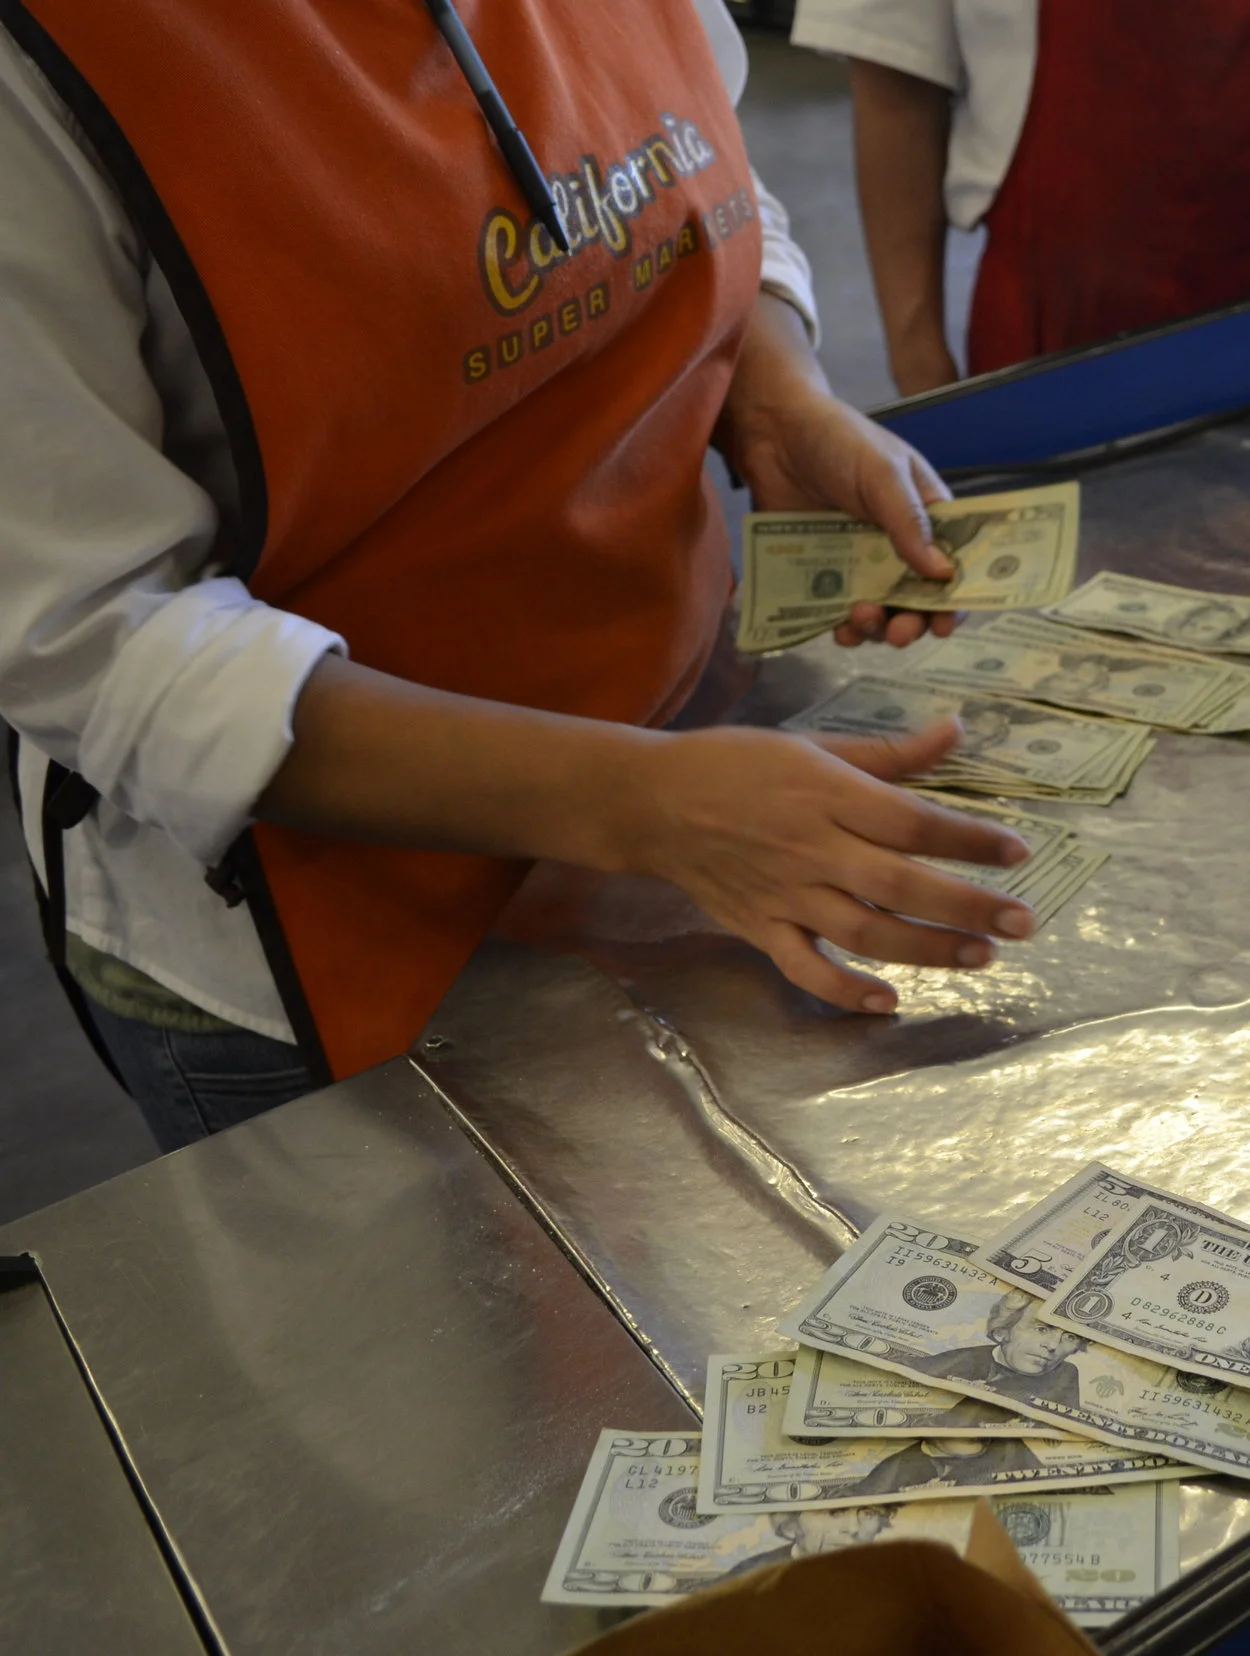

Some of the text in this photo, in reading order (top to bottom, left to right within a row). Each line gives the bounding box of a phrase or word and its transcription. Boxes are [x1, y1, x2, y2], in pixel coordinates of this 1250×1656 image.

[478, 112, 718, 316] California
[465, 283, 609, 384] SUPER
[1098, 1173, 1133, 1196] 5
[1083, 1206, 1109, 1221] L12
[1111, 1199, 1130, 1211] 80
[885, 1222, 949, 1250] 20
[1011, 1248, 1053, 1274] 5
[1201, 1239, 1241, 1263] THE
[1160, 1273, 1170, 1281] 4
[1192, 1290, 1213, 1304] D
[1121, 1312, 1133, 1321] 4
[799, 1317, 891, 1353] 20
[722, 1360, 795, 1380] 20
[747, 1404, 767, 1414] B2
[804, 1407, 908, 1428] 20
[1029, 1395, 1141, 1438] TWENTY
[610, 1438, 688, 1457] 20
[992, 1460, 1112, 1482] TWENTY
[625, 1479, 659, 1489] L12
[713, 1483, 822, 1505] 20
[562, 1569, 677, 1593] 20
